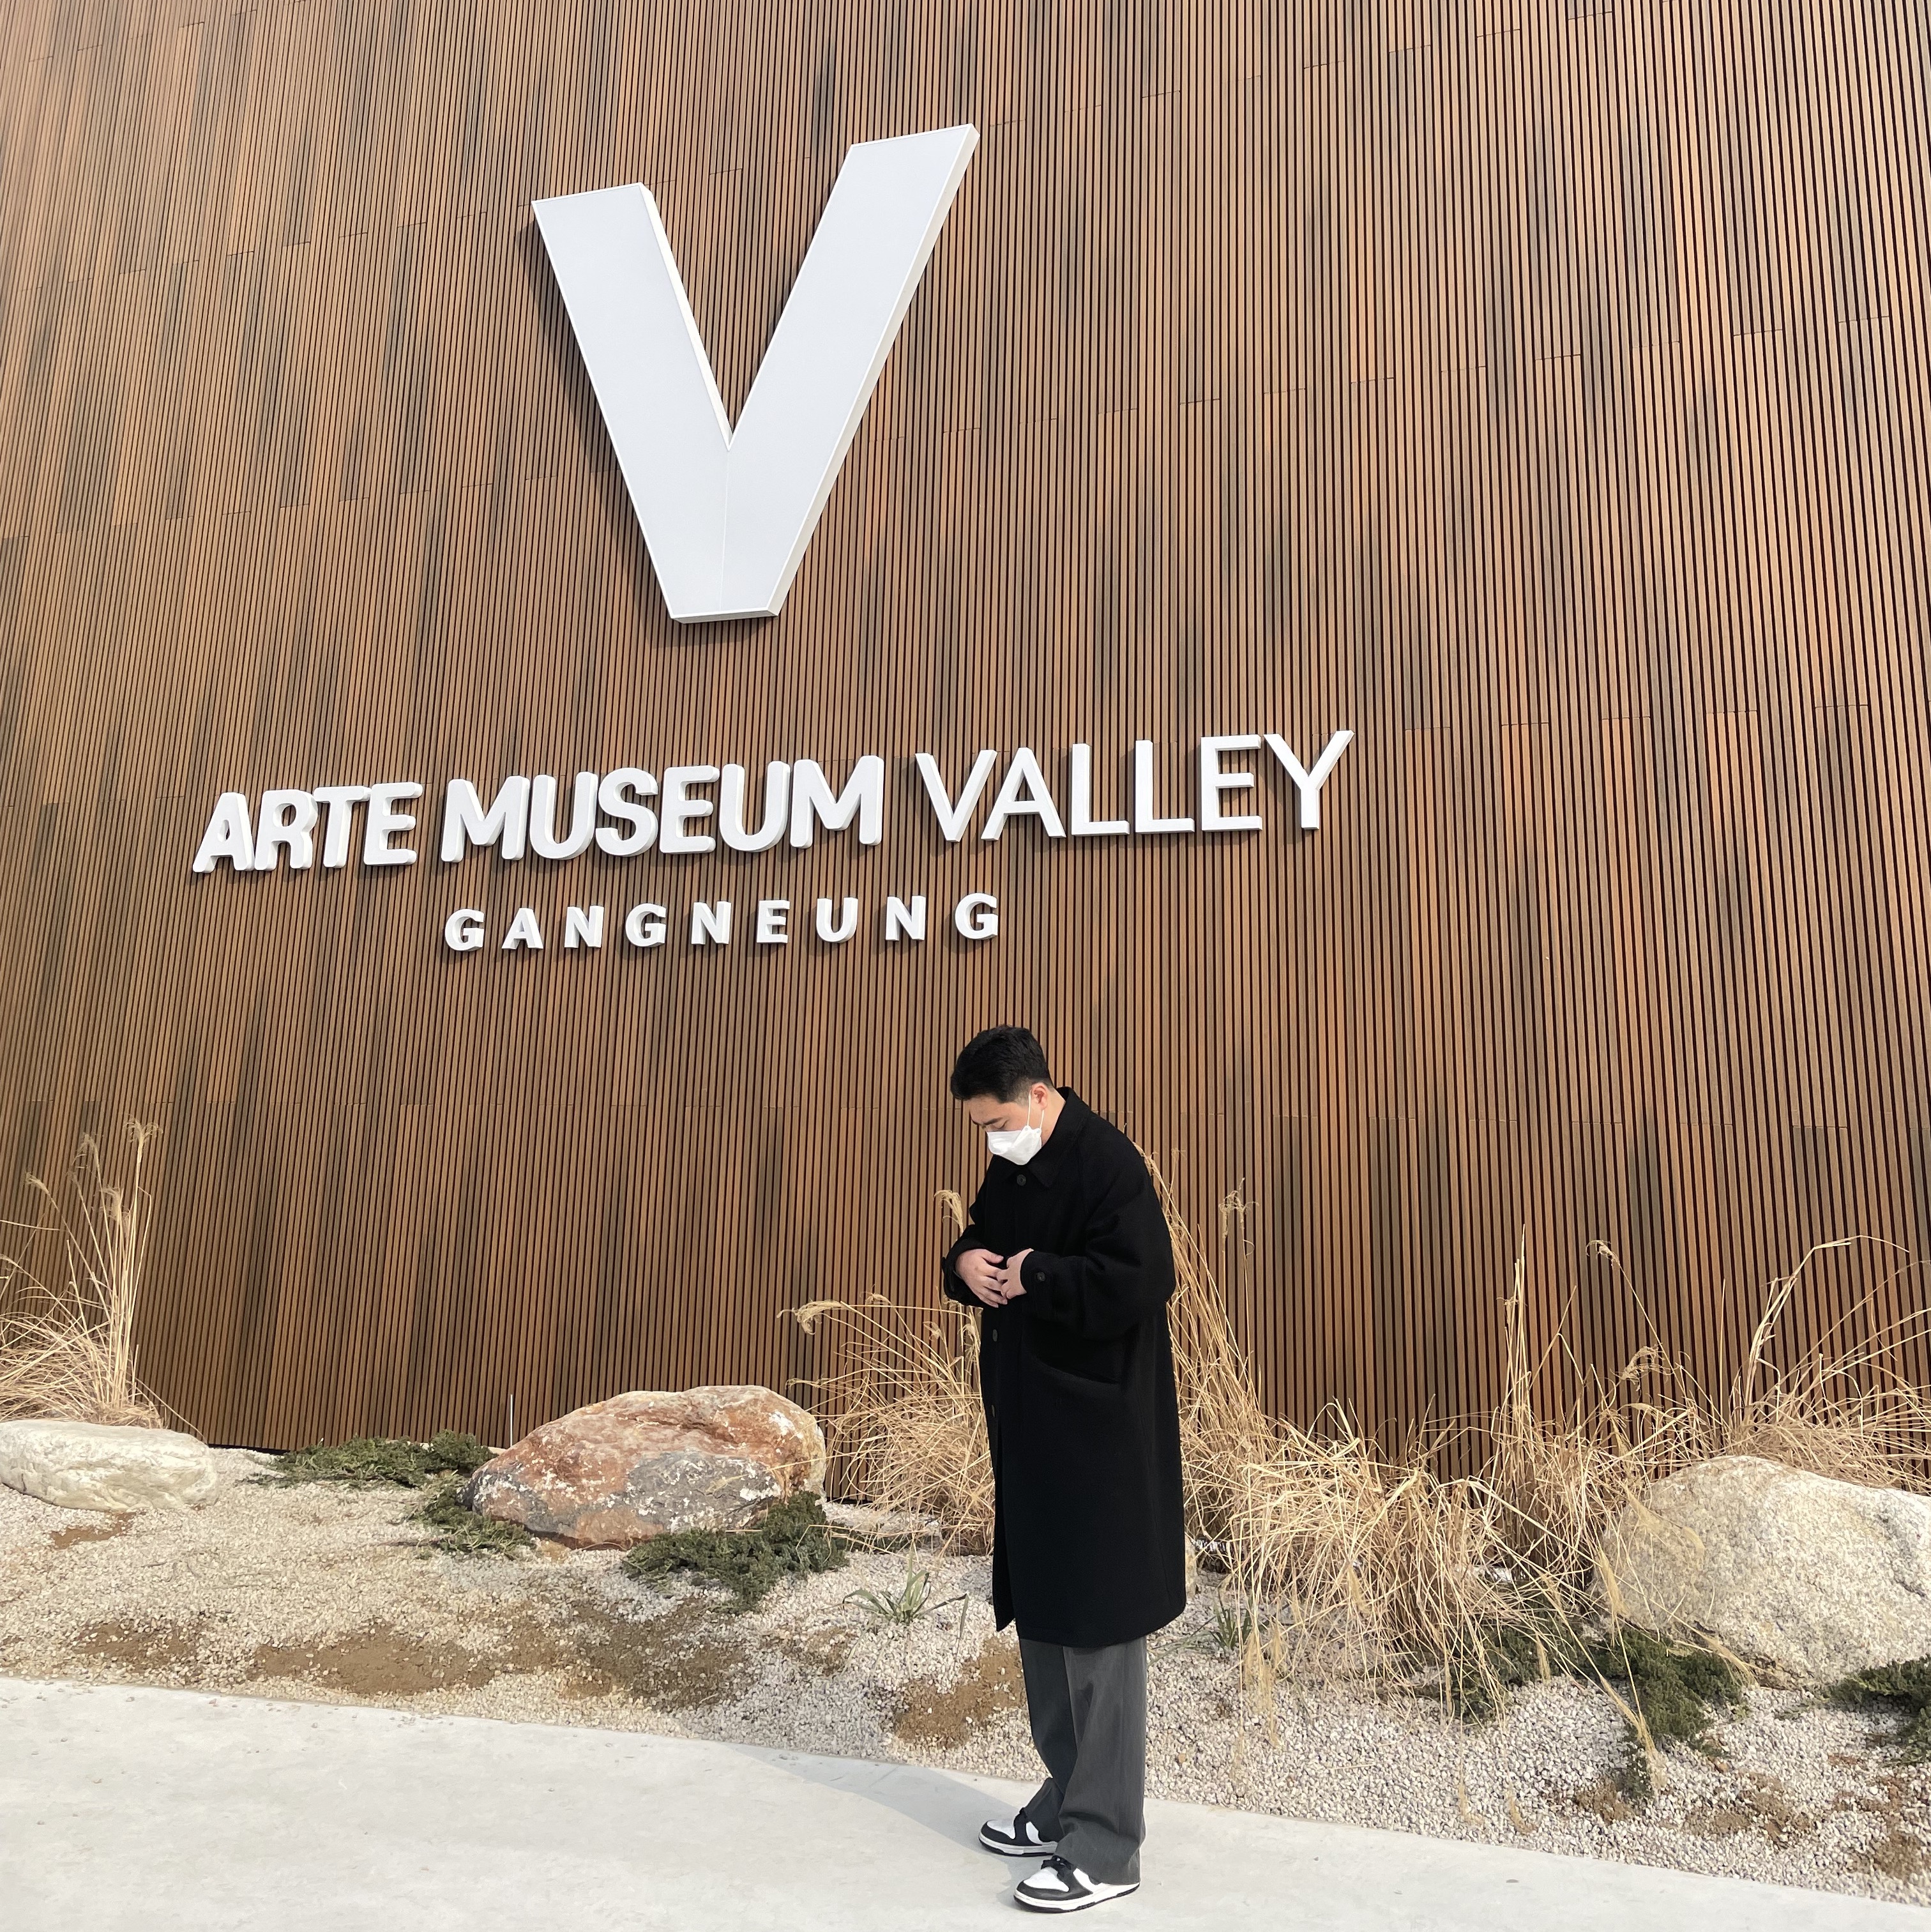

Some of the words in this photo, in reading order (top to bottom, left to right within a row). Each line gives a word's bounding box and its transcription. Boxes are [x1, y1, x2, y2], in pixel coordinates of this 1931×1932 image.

[531, 124, 980, 622] V
[193, 781, 424, 873] ARTE
[441, 755, 885, 862] MUSEUM
[915, 730, 1354, 842] VALLEY
[444, 892, 999, 951] GANGNEUNG
